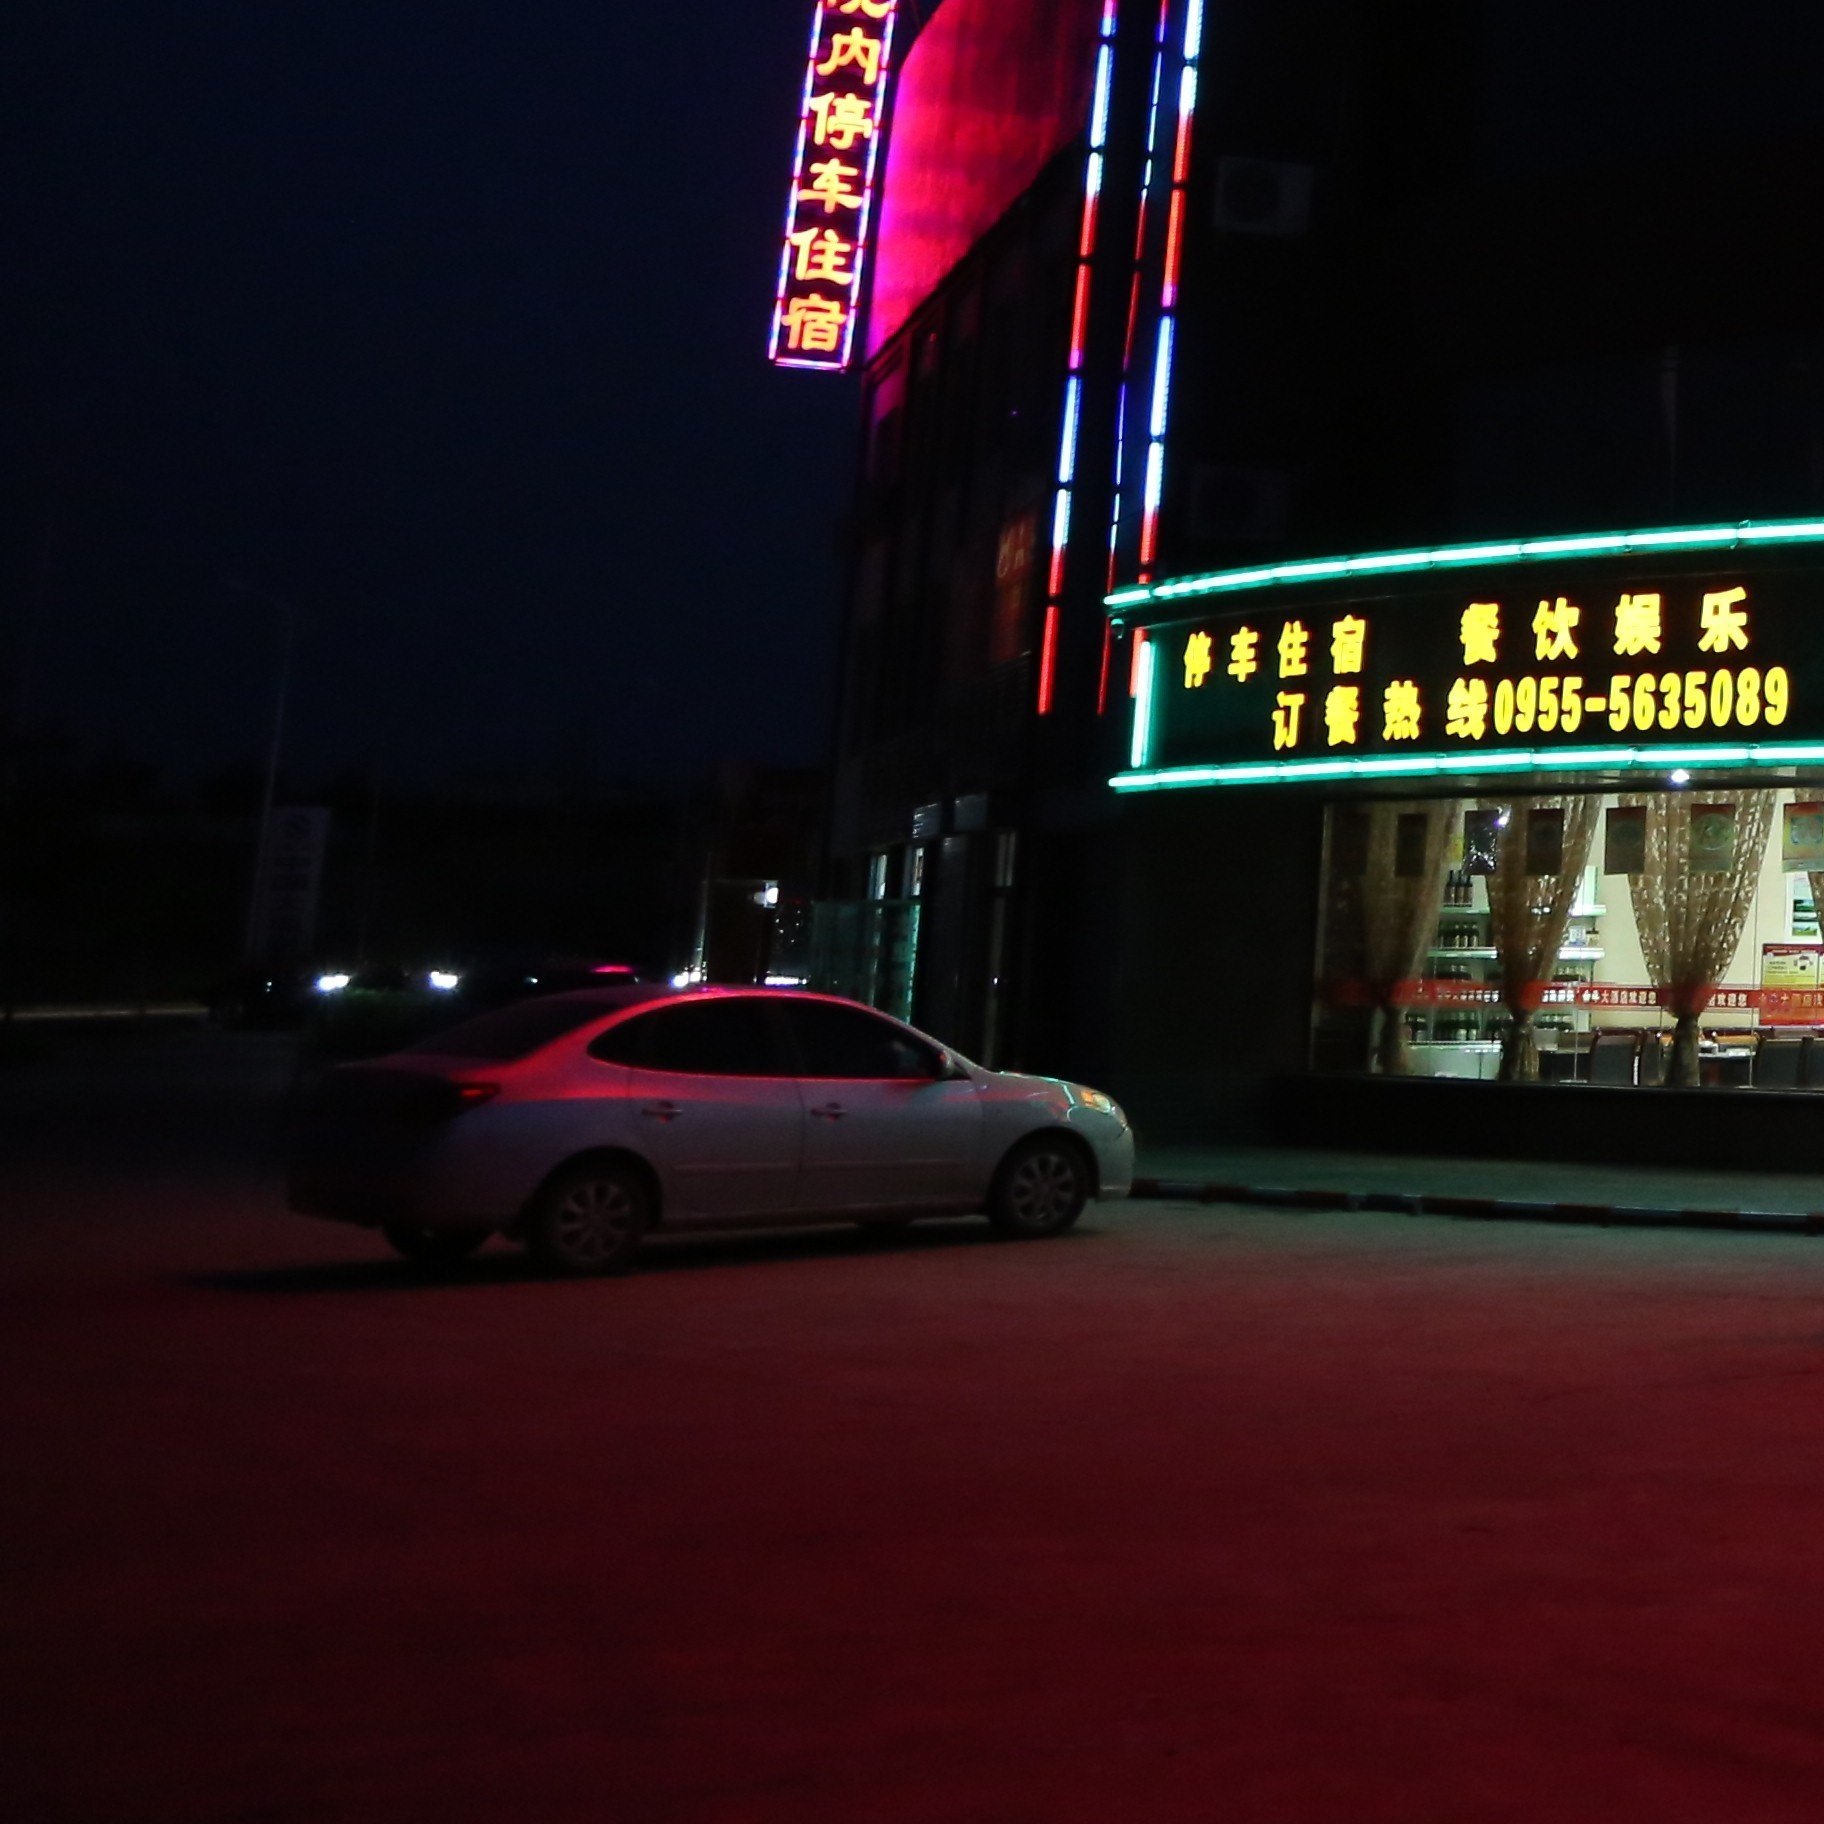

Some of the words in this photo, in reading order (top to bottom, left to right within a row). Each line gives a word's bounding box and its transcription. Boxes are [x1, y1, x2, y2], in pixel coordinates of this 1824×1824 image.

[1184, 614, 1367, 688] 停车住宿
[1460, 586, 1749, 665] 餐饮娱乐
